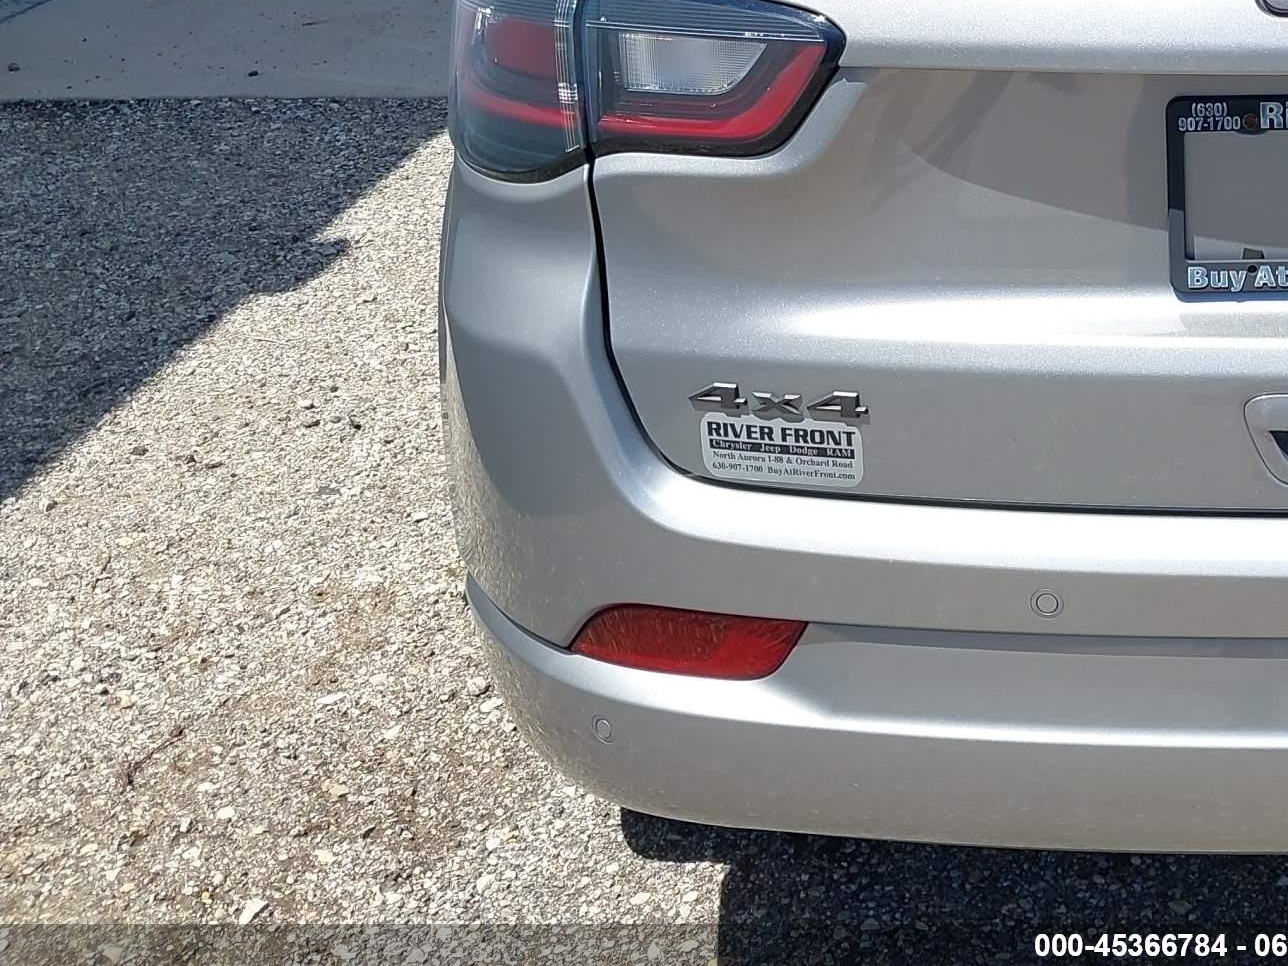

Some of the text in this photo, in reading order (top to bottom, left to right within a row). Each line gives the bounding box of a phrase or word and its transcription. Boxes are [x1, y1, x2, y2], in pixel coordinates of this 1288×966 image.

[1191, 102, 1228, 117] (630)
[1178, 116, 1241, 131] 907-1700
[1187, 266, 1248, 292] Buy
[706, 421, 856, 447] RIVER FRONT
[712, 439, 851, 458] Chrysler Jeep Dodge RAM
[713, 451, 736, 461] North
[737, 453, 766, 463] Aurora
[785, 456, 794, 465] &
[795, 457, 830, 467] Orchard
[832, 460, 853, 469] Road
[712, 461, 856, 480] 630-907-1700 BuyAtRiverFront.com
